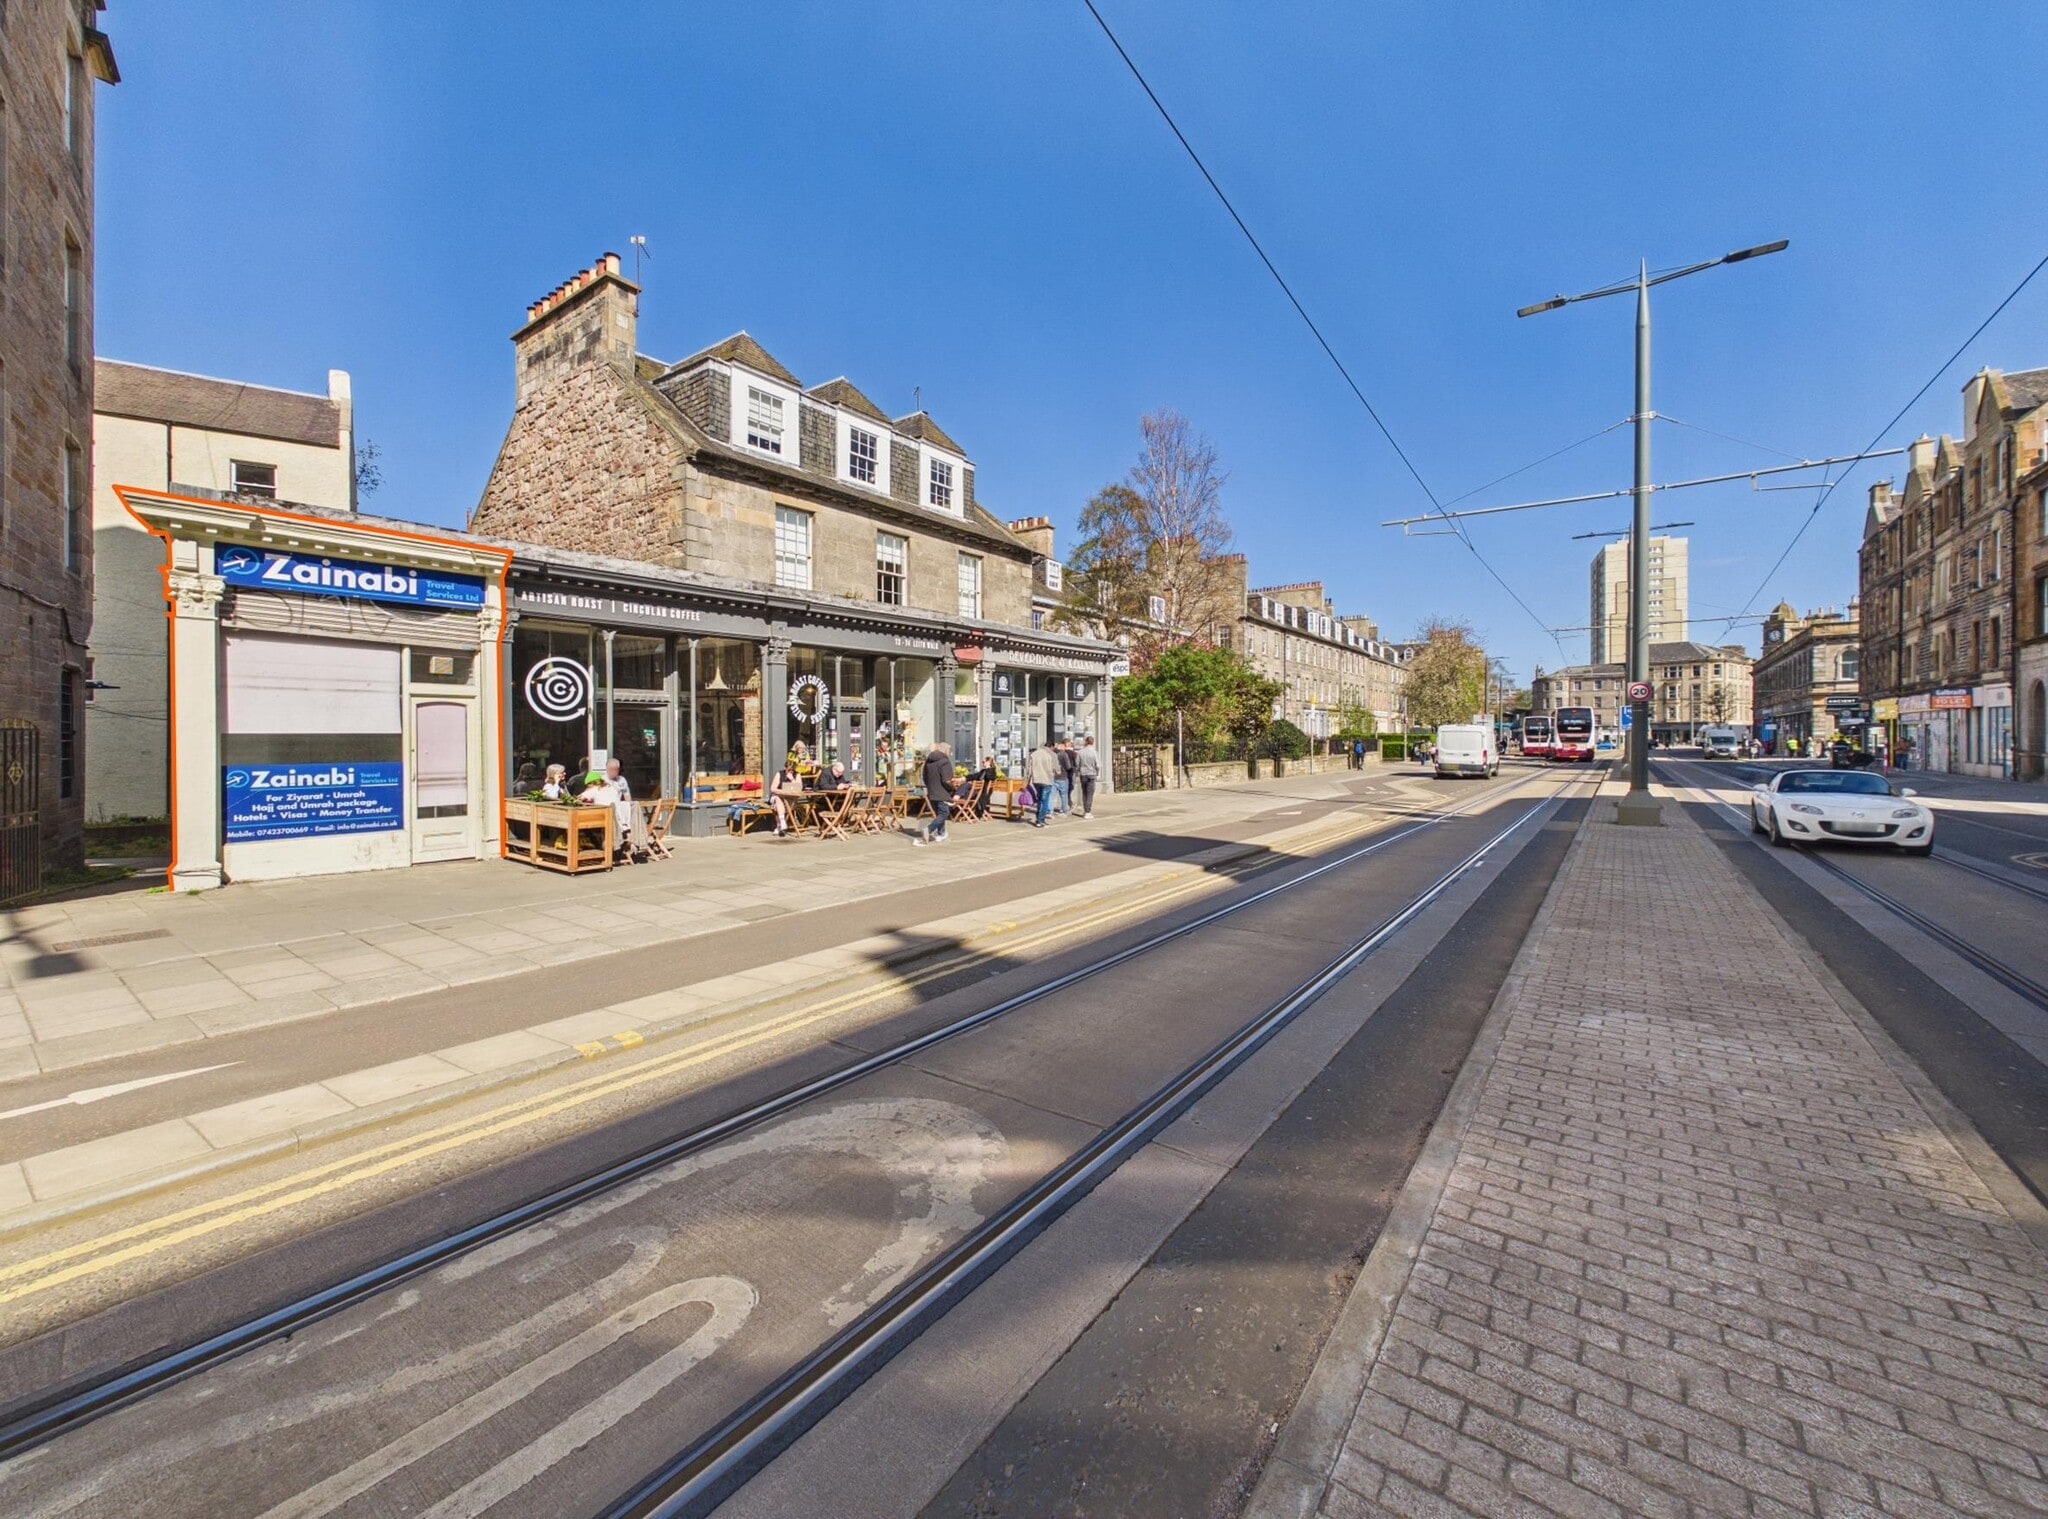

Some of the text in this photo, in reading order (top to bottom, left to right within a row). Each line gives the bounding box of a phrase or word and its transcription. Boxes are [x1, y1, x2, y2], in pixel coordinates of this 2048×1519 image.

[262, 553, 418, 595] Zainabi
[426, 580, 455, 591] Travel
[426, 589, 480, 602] Services Ltd
[521, 591, 701, 621] ARTISAN ROAST CIRCULAR COFFEE
[1633, 688, 1648, 696] 20
[250, 767, 355, 789] Zainabi
[266, 794, 283, 802] For
[286, 793, 324, 802] Ziyarat
[333, 790, 366, 799] Umrah
[252, 799, 377, 813] Hajj and Umrah package
[233, 805, 393, 822] Hotels Visas Money Transfer
